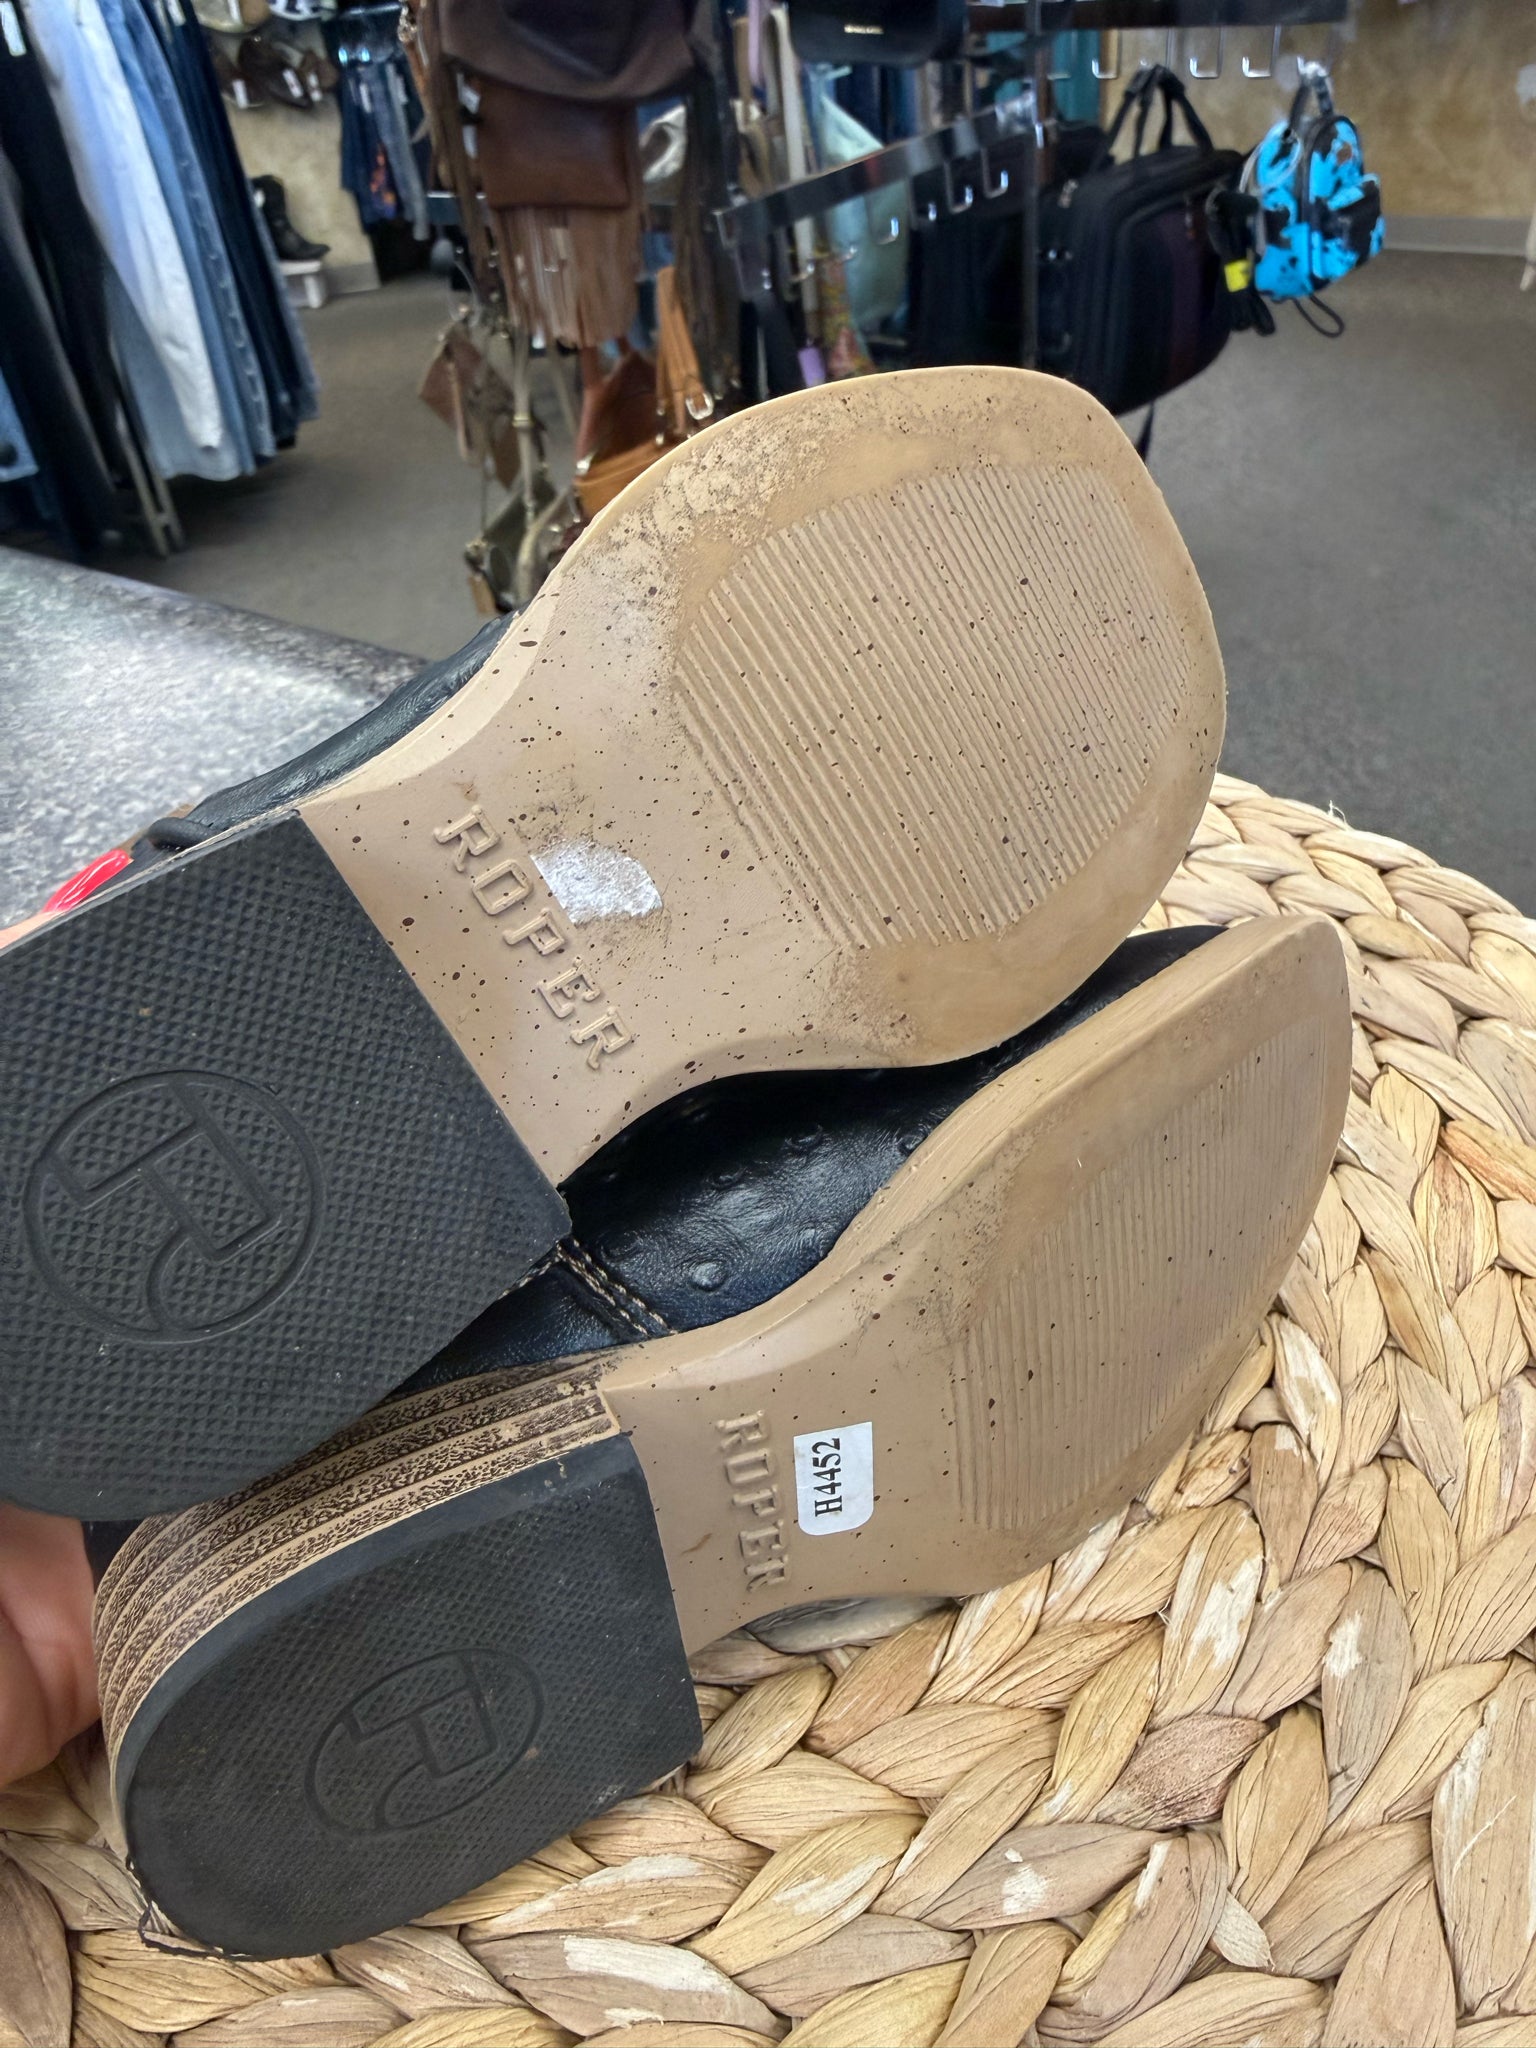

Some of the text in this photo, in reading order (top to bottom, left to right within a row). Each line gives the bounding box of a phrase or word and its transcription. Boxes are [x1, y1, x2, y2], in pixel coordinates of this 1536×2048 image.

[433, 804, 632, 1070] ROPER
[715, 1410, 791, 1593] ROPER
[811, 1437, 843, 1517] H4452
